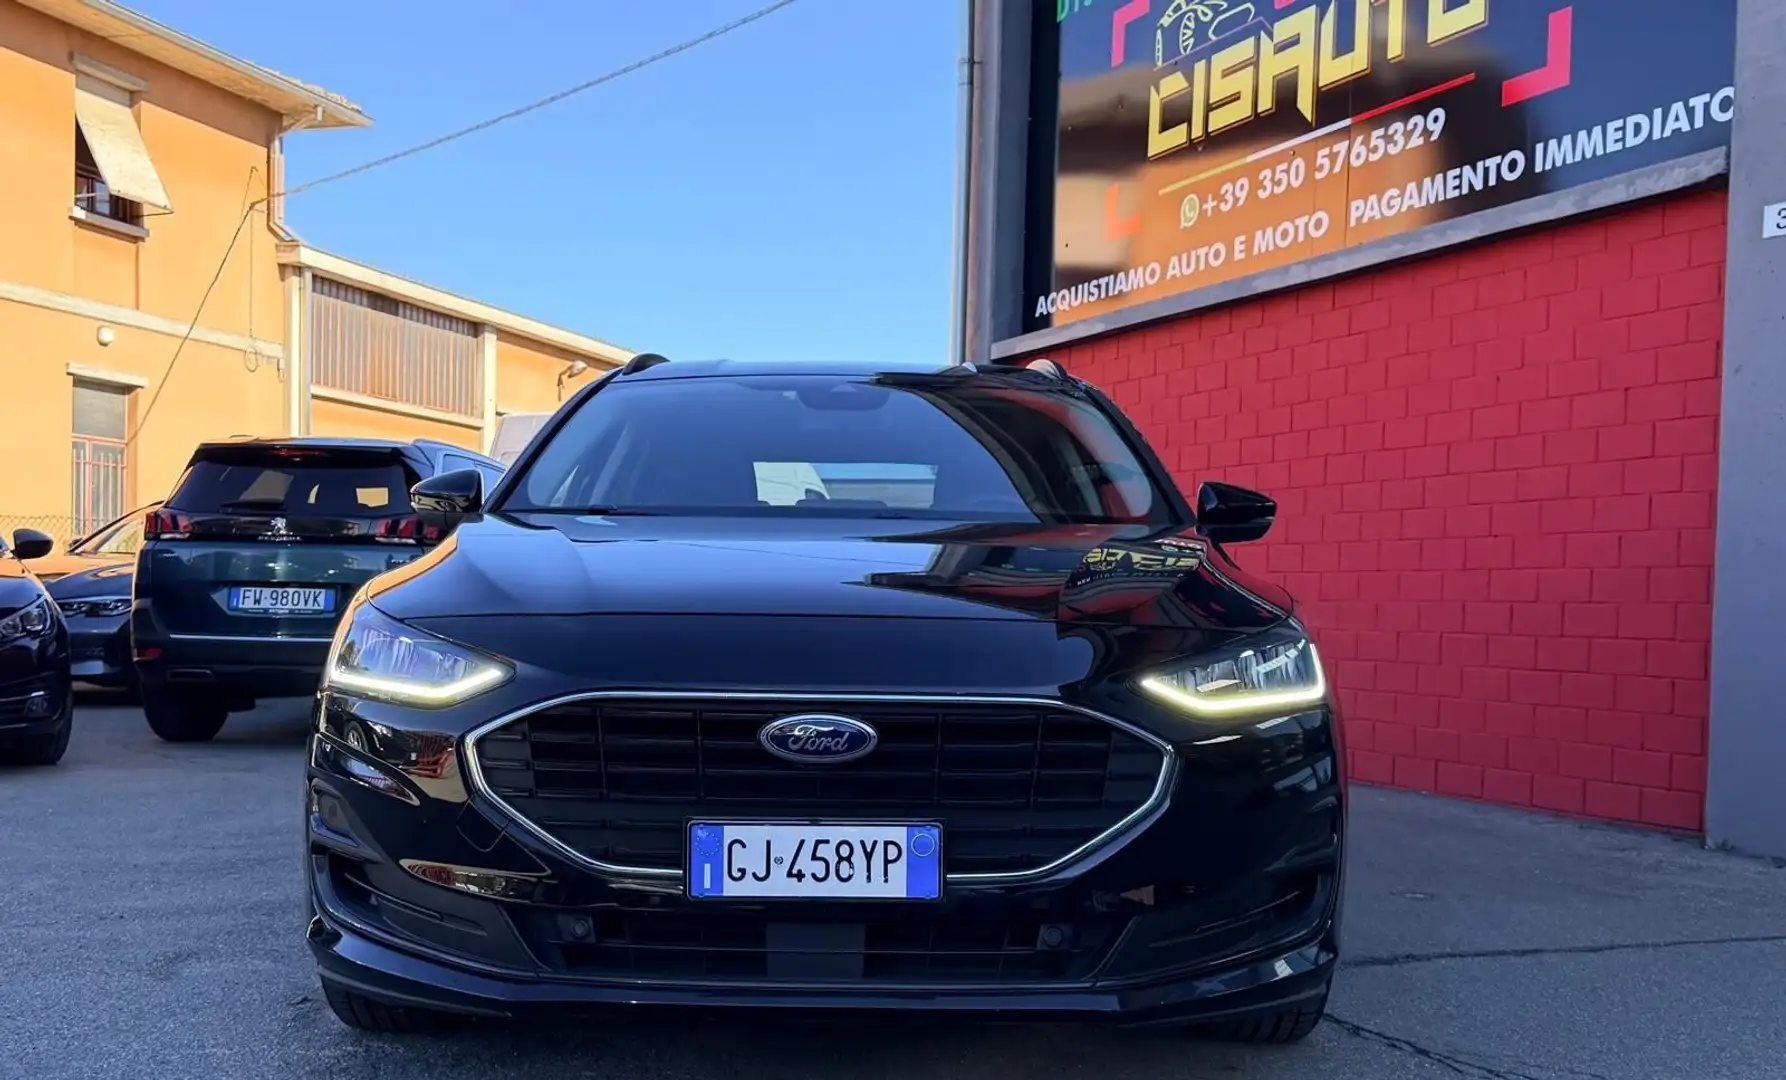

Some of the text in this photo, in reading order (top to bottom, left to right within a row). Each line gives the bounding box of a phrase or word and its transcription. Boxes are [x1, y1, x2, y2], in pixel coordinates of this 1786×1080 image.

[1202, 107, 1446, 217] +39 350 5765329
[1349, 150, 1526, 227] PAGAMENTO
[1035, 210, 1330, 318] ACQUISTIAMO AUTO E MOTO
[787, 724, 850, 752] Ford
